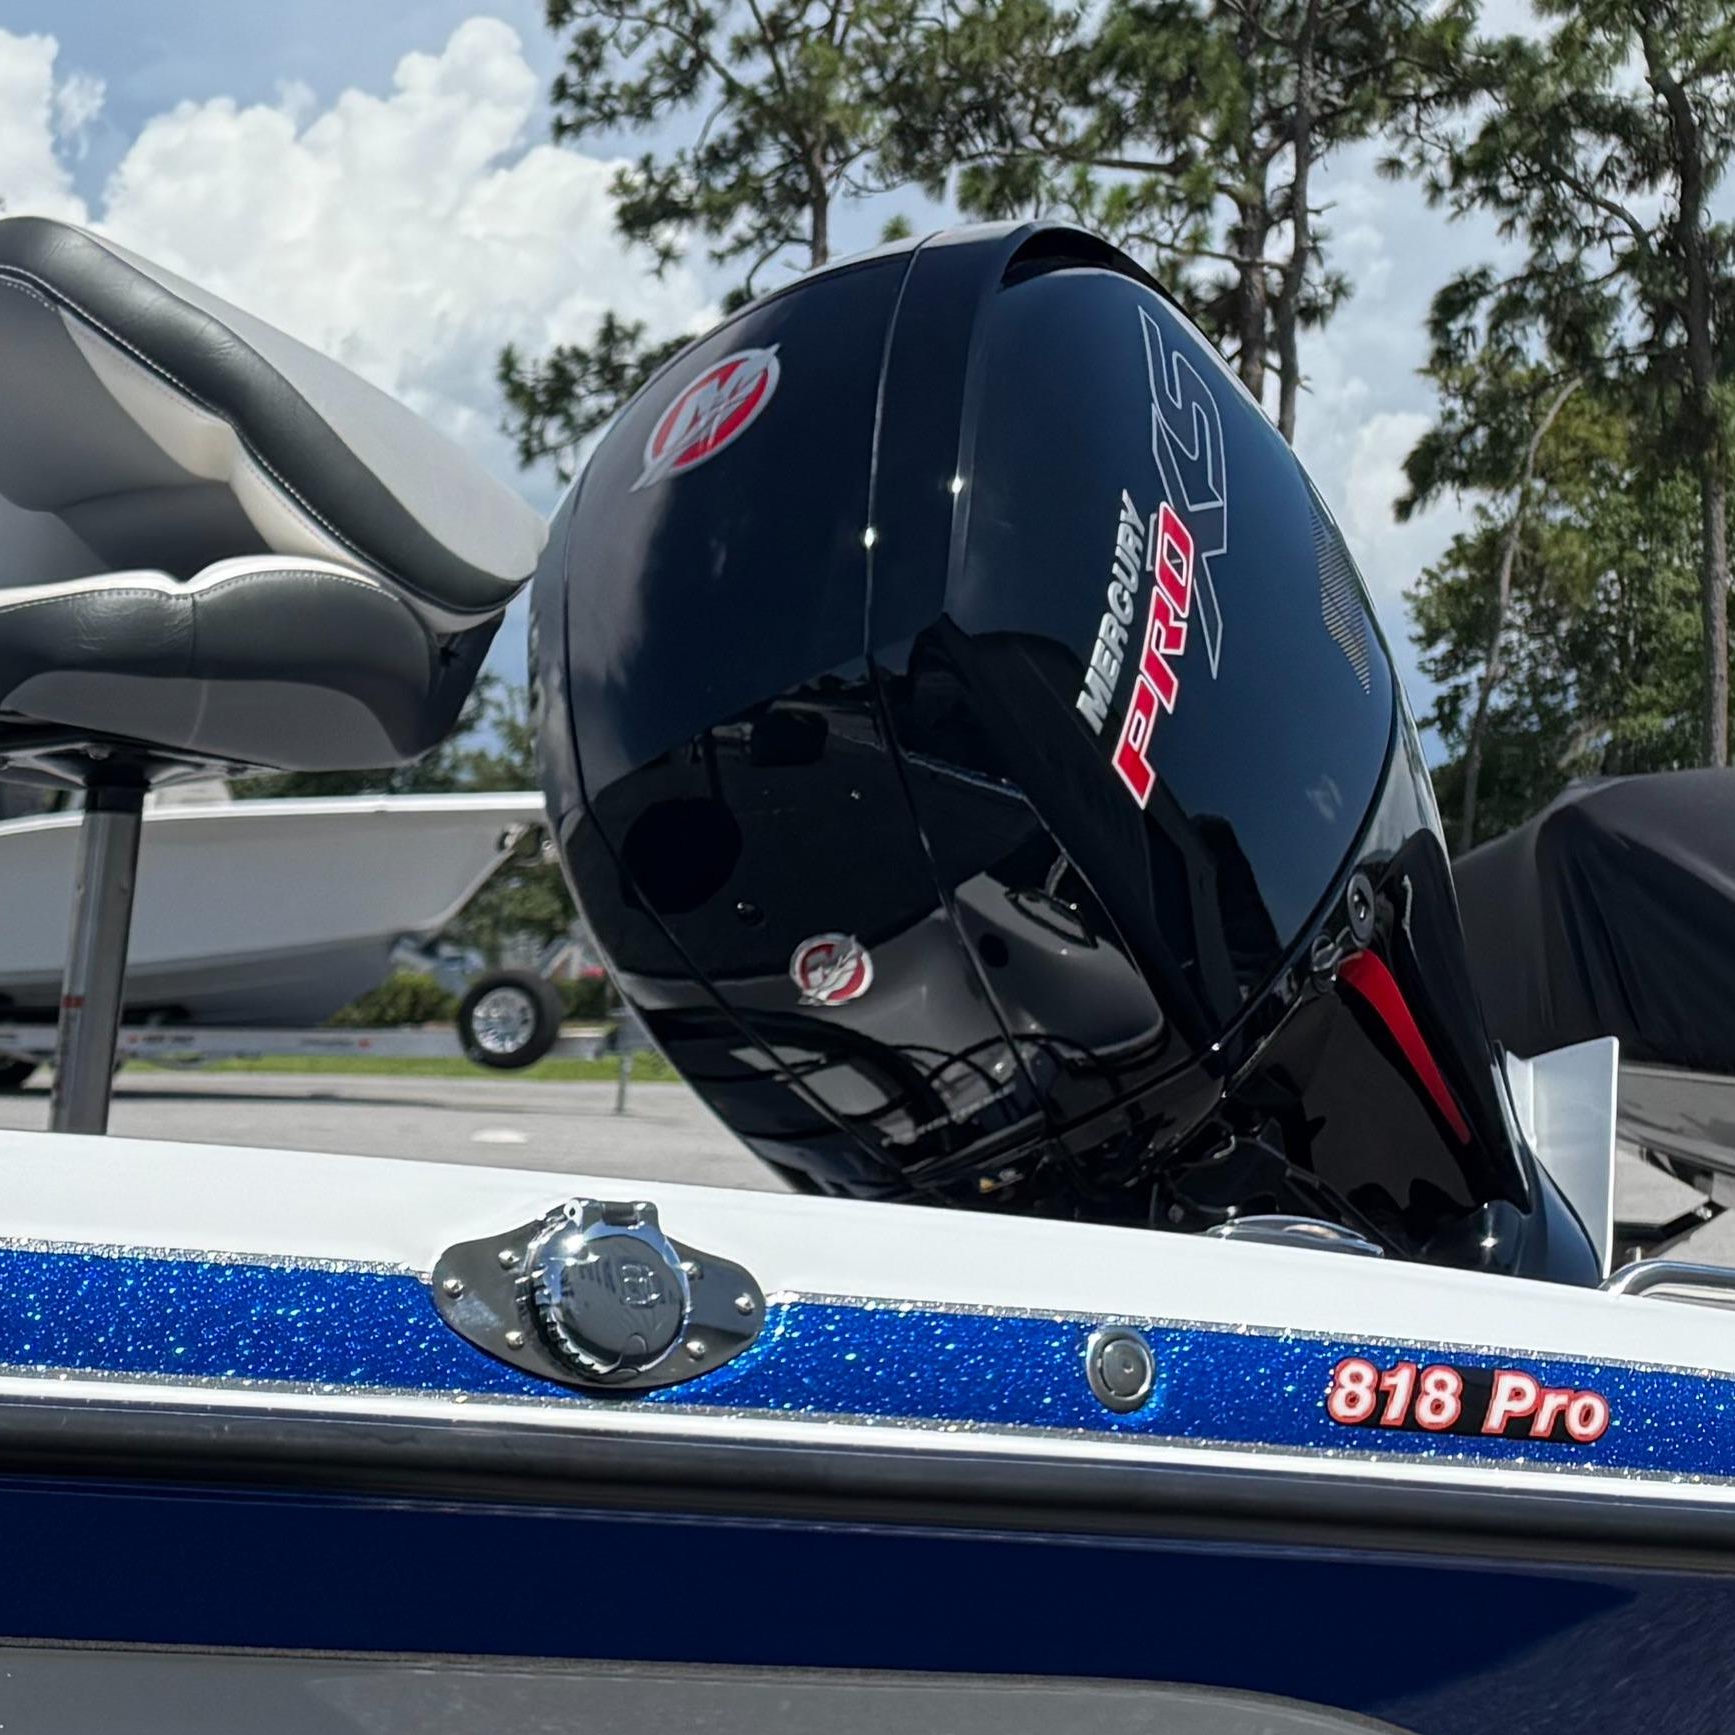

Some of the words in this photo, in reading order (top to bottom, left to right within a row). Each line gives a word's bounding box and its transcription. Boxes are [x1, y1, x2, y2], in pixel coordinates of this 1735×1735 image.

[1076, 488, 1145, 736] MERCURY
[1112, 501, 1194, 810] PRO
[1328, 1357, 1463, 1432] 818
[1481, 1369, 1610, 1443] Pro
